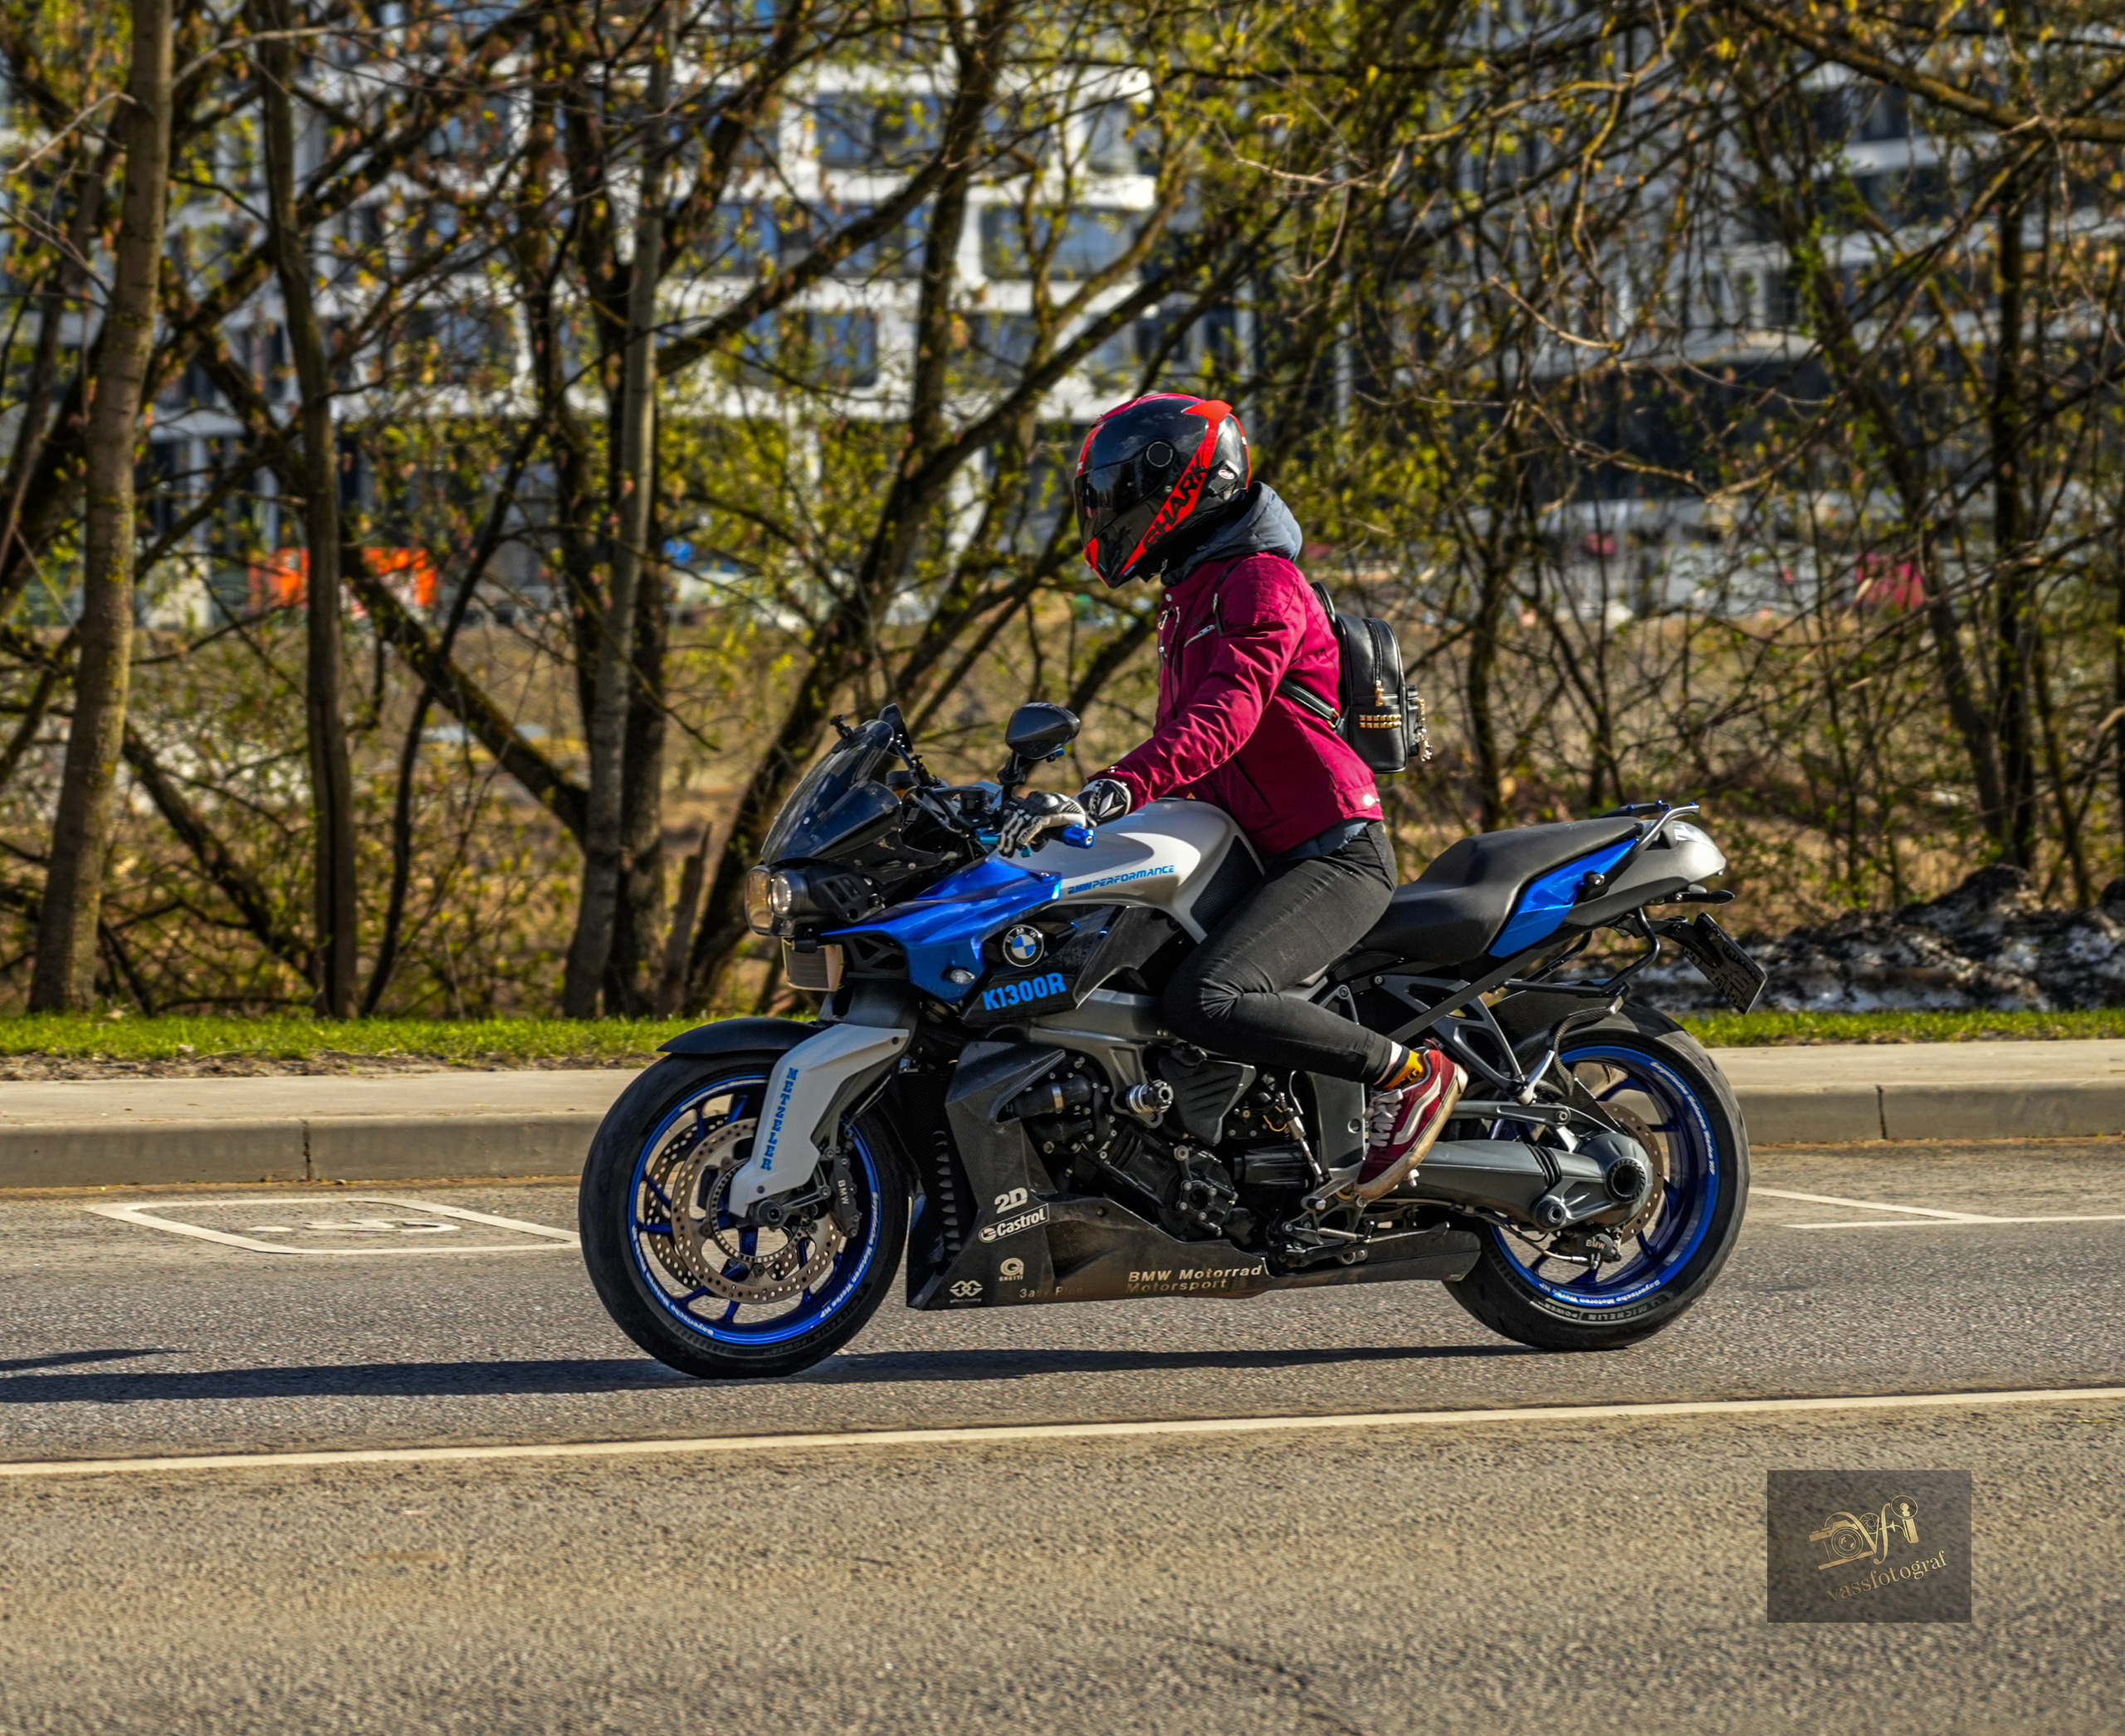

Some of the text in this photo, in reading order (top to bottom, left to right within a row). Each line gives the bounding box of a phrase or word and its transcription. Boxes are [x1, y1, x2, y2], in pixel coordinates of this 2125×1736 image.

[1143, 452, 1209, 550] SHARK
[1092, 864, 1175, 888] PERFORMANCE
[982, 972, 1067, 1011] K1300R
[761, 1068, 799, 1171] METZELER
[838, 1179, 849, 1205] BMW
[994, 1187, 1028, 1215] 2D
[996, 1208, 1046, 1237] Castrol
[1585, 1238, 1606, 1251] BMW
[1126, 1278, 1228, 1293] Motorsport
[1127, 1264, 1263, 1283] BMW Motorrad
[1551, 1289, 1579, 1303] Werke
[1579, 1297, 1615, 1306] Motoren
[1615, 1279, 1662, 1305] Bayerische
[1587, 1304, 1649, 1321] MICHELIN
